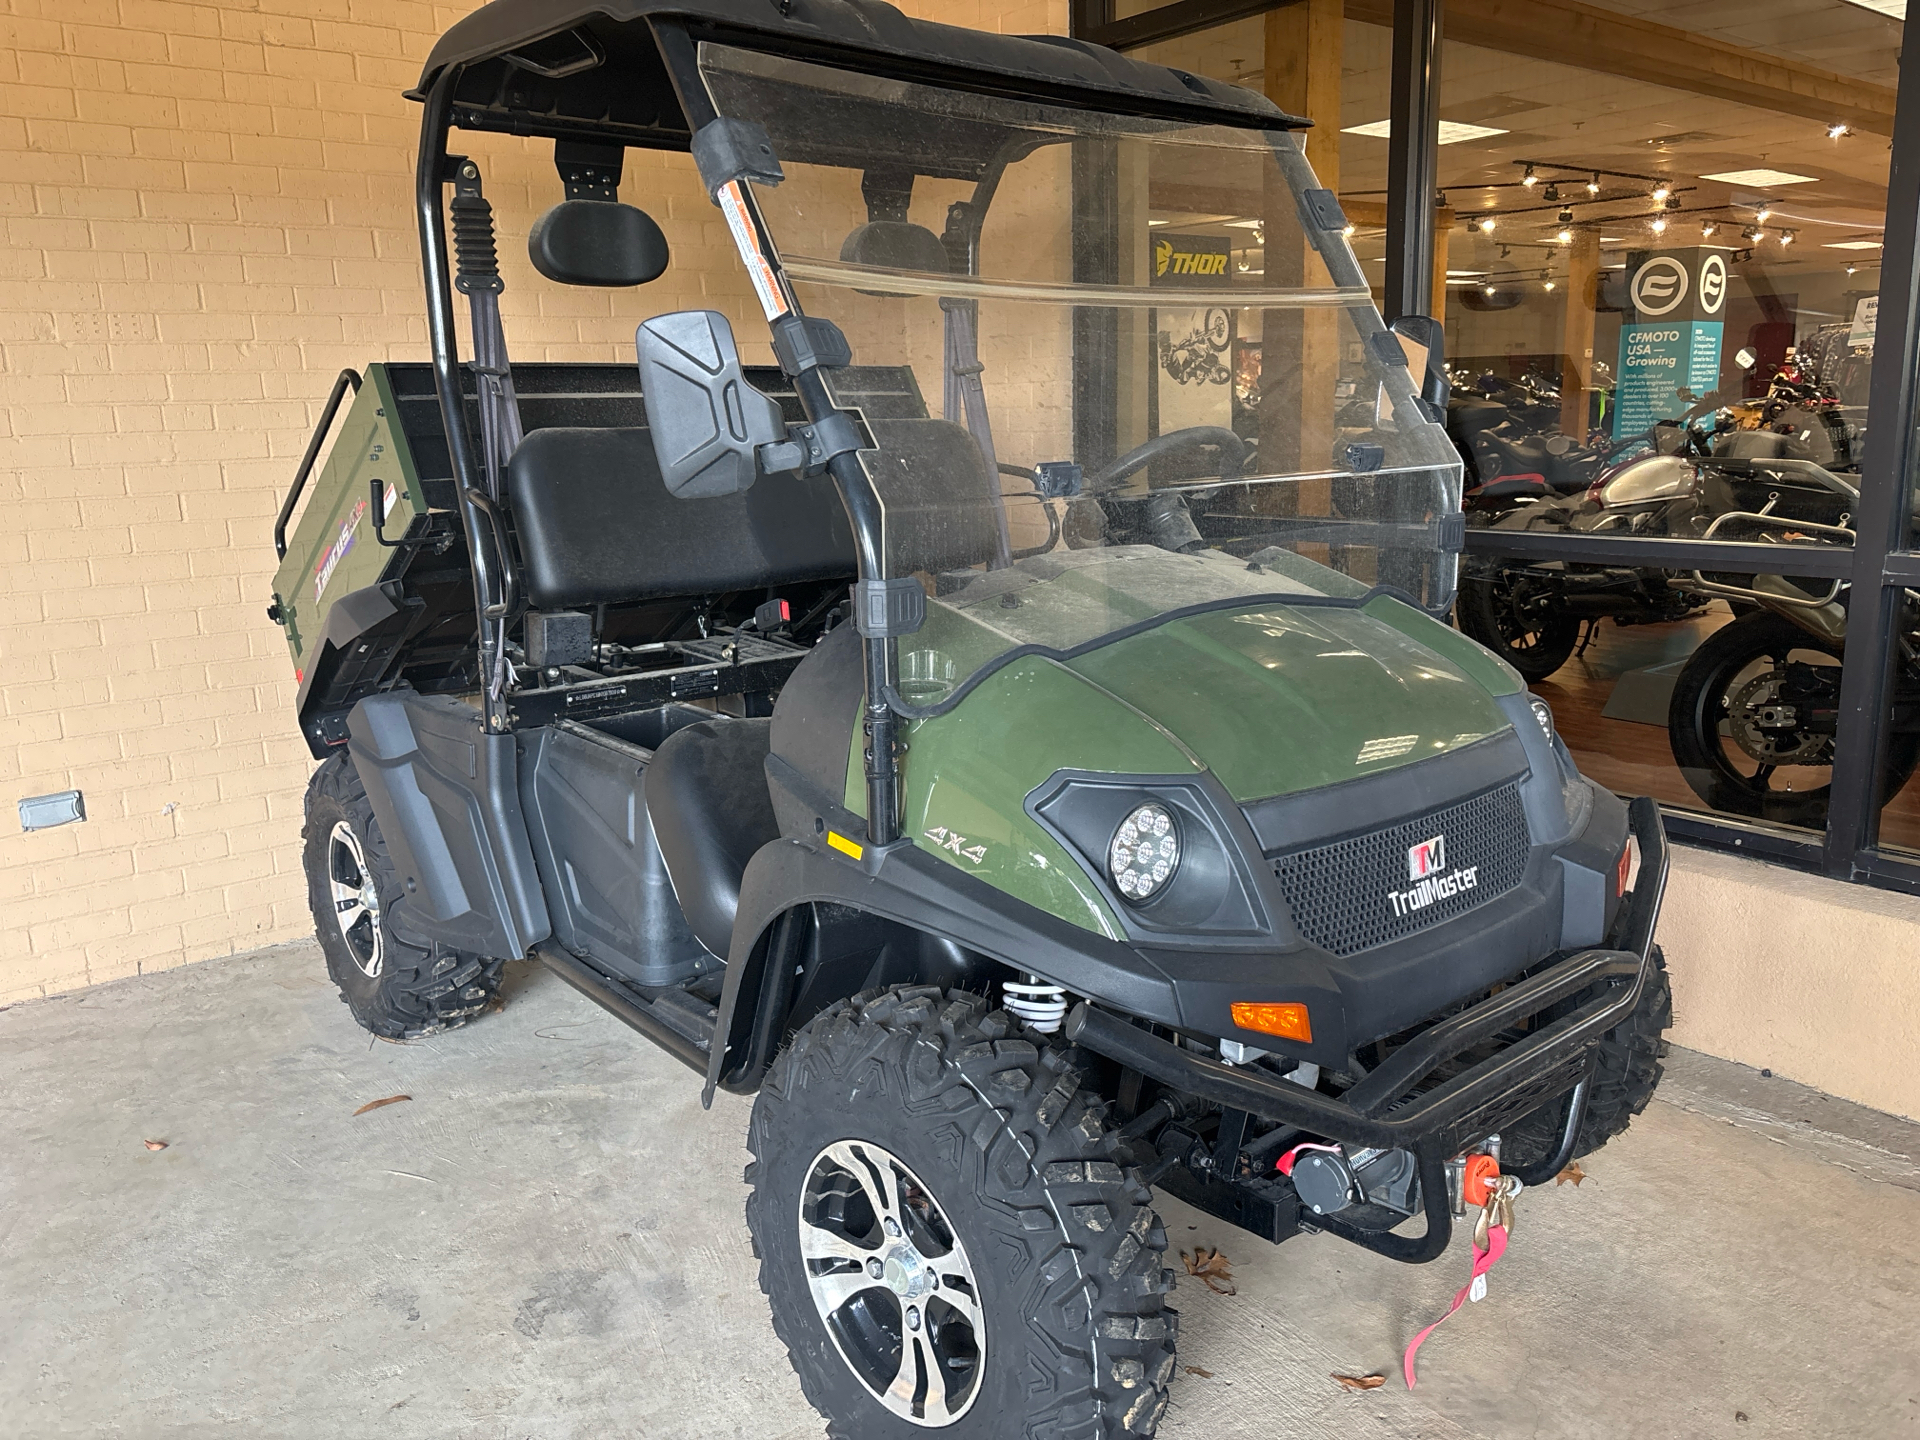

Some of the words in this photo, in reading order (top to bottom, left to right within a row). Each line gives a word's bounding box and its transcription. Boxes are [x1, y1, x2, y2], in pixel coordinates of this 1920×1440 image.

[740, 208, 753, 232] WARNING
[1172, 253, 1229, 275] THOR
[764, 269, 780, 300] WARNING
[1628, 330, 1680, 343] CFMOTO
[1627, 344, 1651, 355] USA
[1626, 355, 1677, 368] Growing
[1646, 379, 1675, 387] engineered
[1387, 865, 1478, 917] TrailMaster
